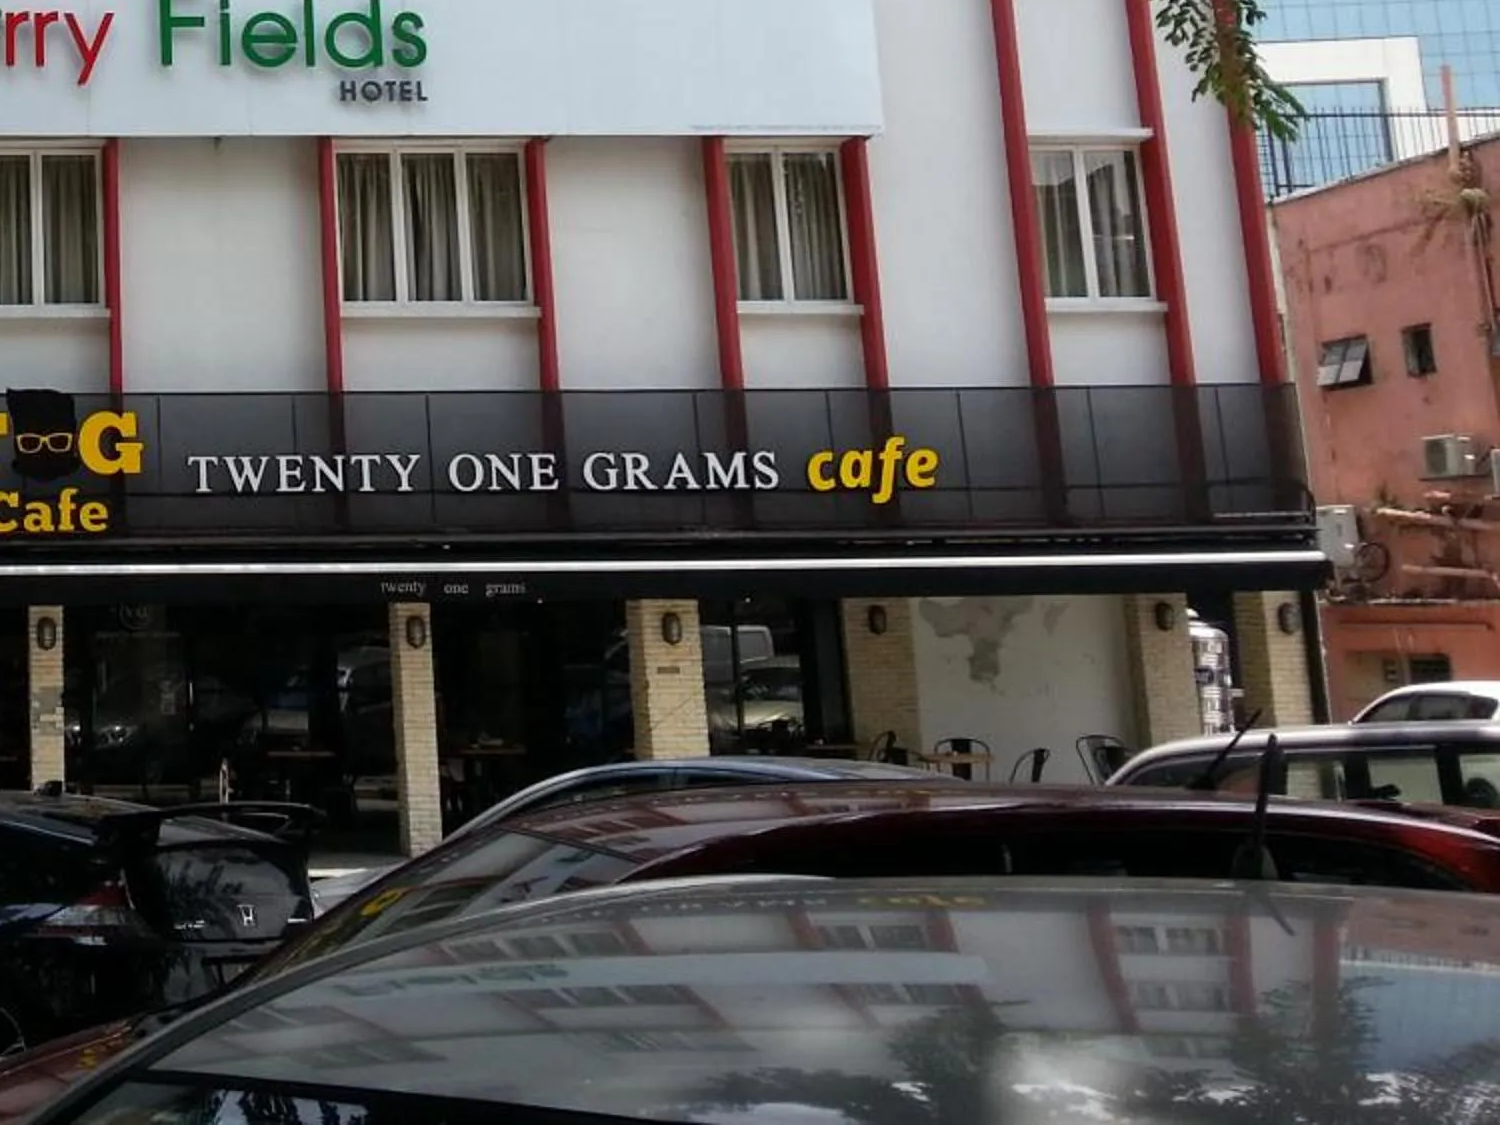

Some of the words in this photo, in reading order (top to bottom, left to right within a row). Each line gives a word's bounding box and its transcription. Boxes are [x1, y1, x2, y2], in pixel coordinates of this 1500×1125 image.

[339, 80, 429, 102] HOTEL
[187, 453, 422, 493] TWENTY
[448, 452, 560, 492] ONE
[582, 450, 780, 491] GRAMS
[806, 436, 939, 505] cafe
[443, 582, 469, 594] one
